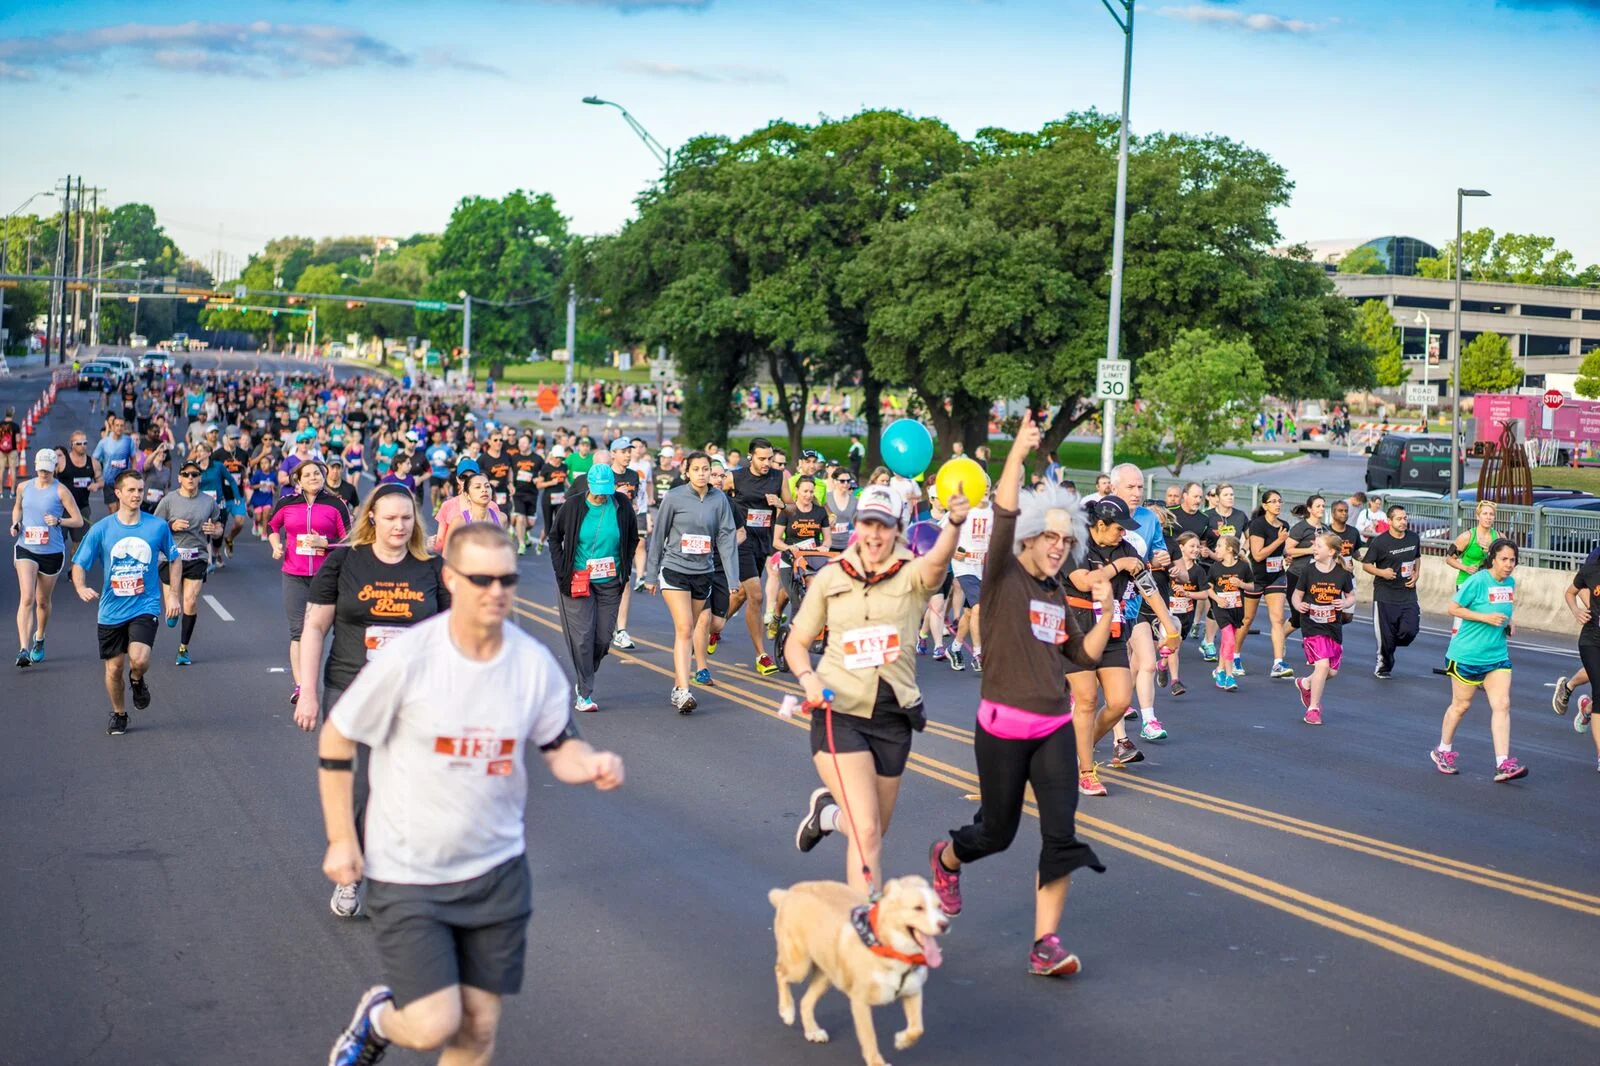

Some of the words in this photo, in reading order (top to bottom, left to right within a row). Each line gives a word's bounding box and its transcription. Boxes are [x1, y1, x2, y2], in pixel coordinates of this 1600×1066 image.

[1102, 381, 1124, 395] 30
[1544, 394, 1563, 404] STOP
[117, 580, 138, 589] 1027
[1310, 584, 1341, 594] Sunshine
[358, 584, 425, 602] Sunshine
[372, 599, 411, 615] Run
